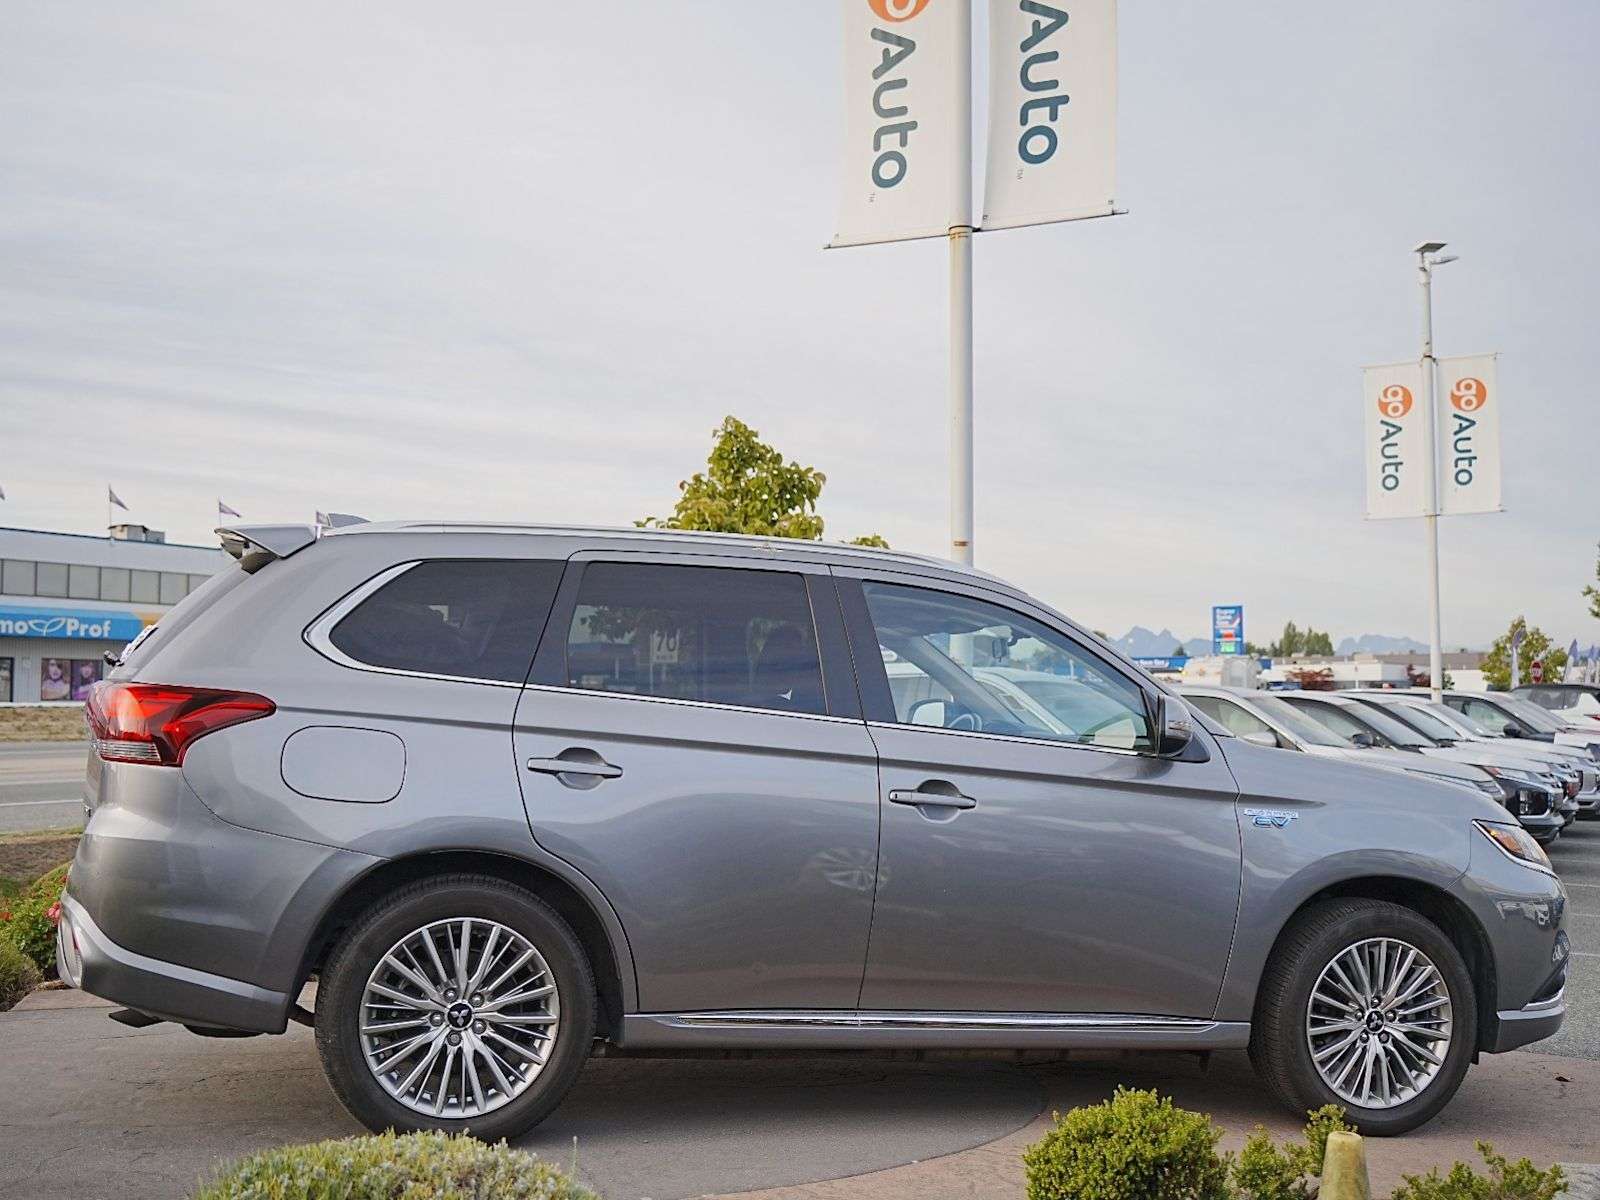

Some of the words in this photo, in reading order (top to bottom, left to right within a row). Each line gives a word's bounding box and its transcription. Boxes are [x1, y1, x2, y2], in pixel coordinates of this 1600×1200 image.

[871, 27, 918, 188] Auto
[1018, 0, 1070, 164] Auto
[1378, 386, 1405, 417] go
[1451, 379, 1478, 411] go
[1380, 420, 1404, 491] Auto
[1452, 413, 1477, 486] Auto
[67, 617, 111, 638] Prof
